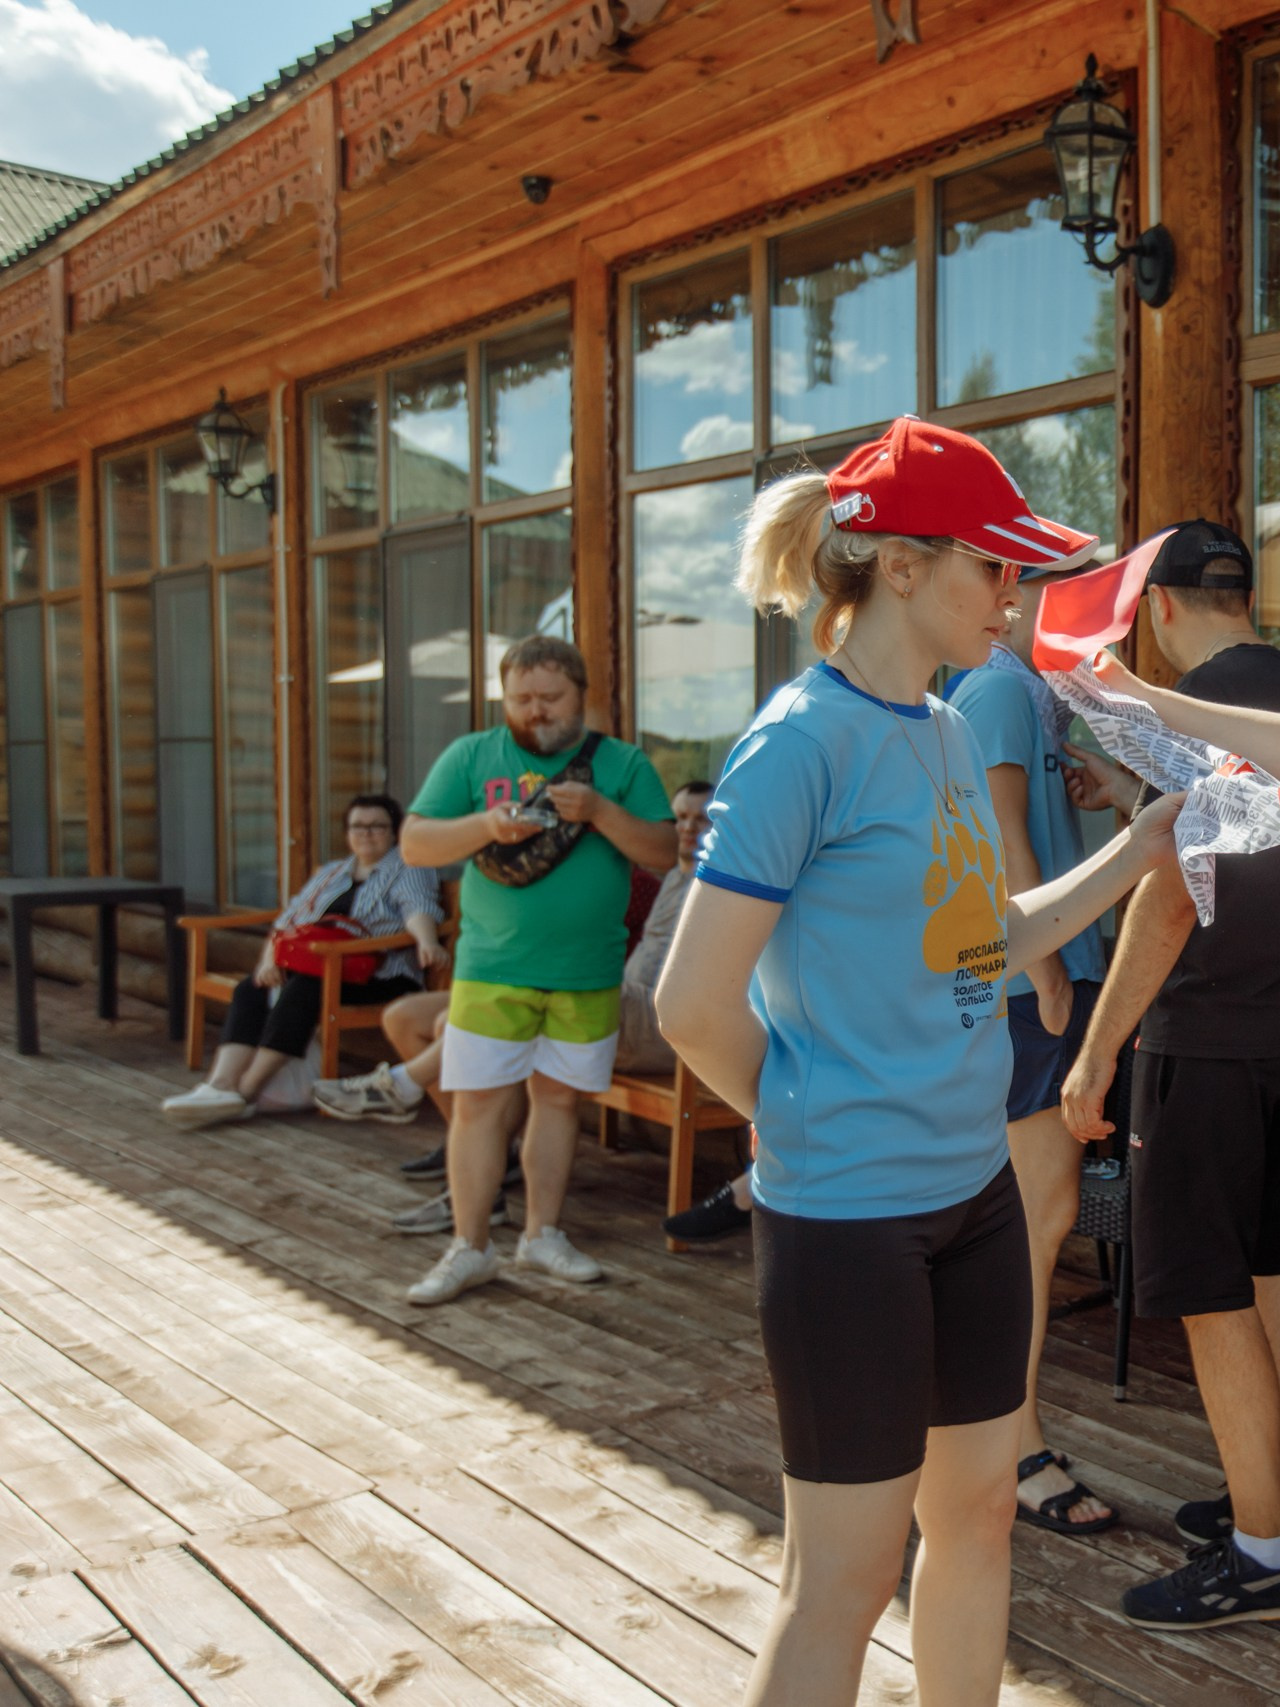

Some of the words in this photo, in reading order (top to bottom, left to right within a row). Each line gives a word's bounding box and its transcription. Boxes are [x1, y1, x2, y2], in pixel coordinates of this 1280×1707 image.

[955, 957, 1008, 981] ПОЛУМАРА
[952, 980, 993, 996] ЗОЛОТОЕ
[955, 992, 994, 1007] КОЛЬЦО
